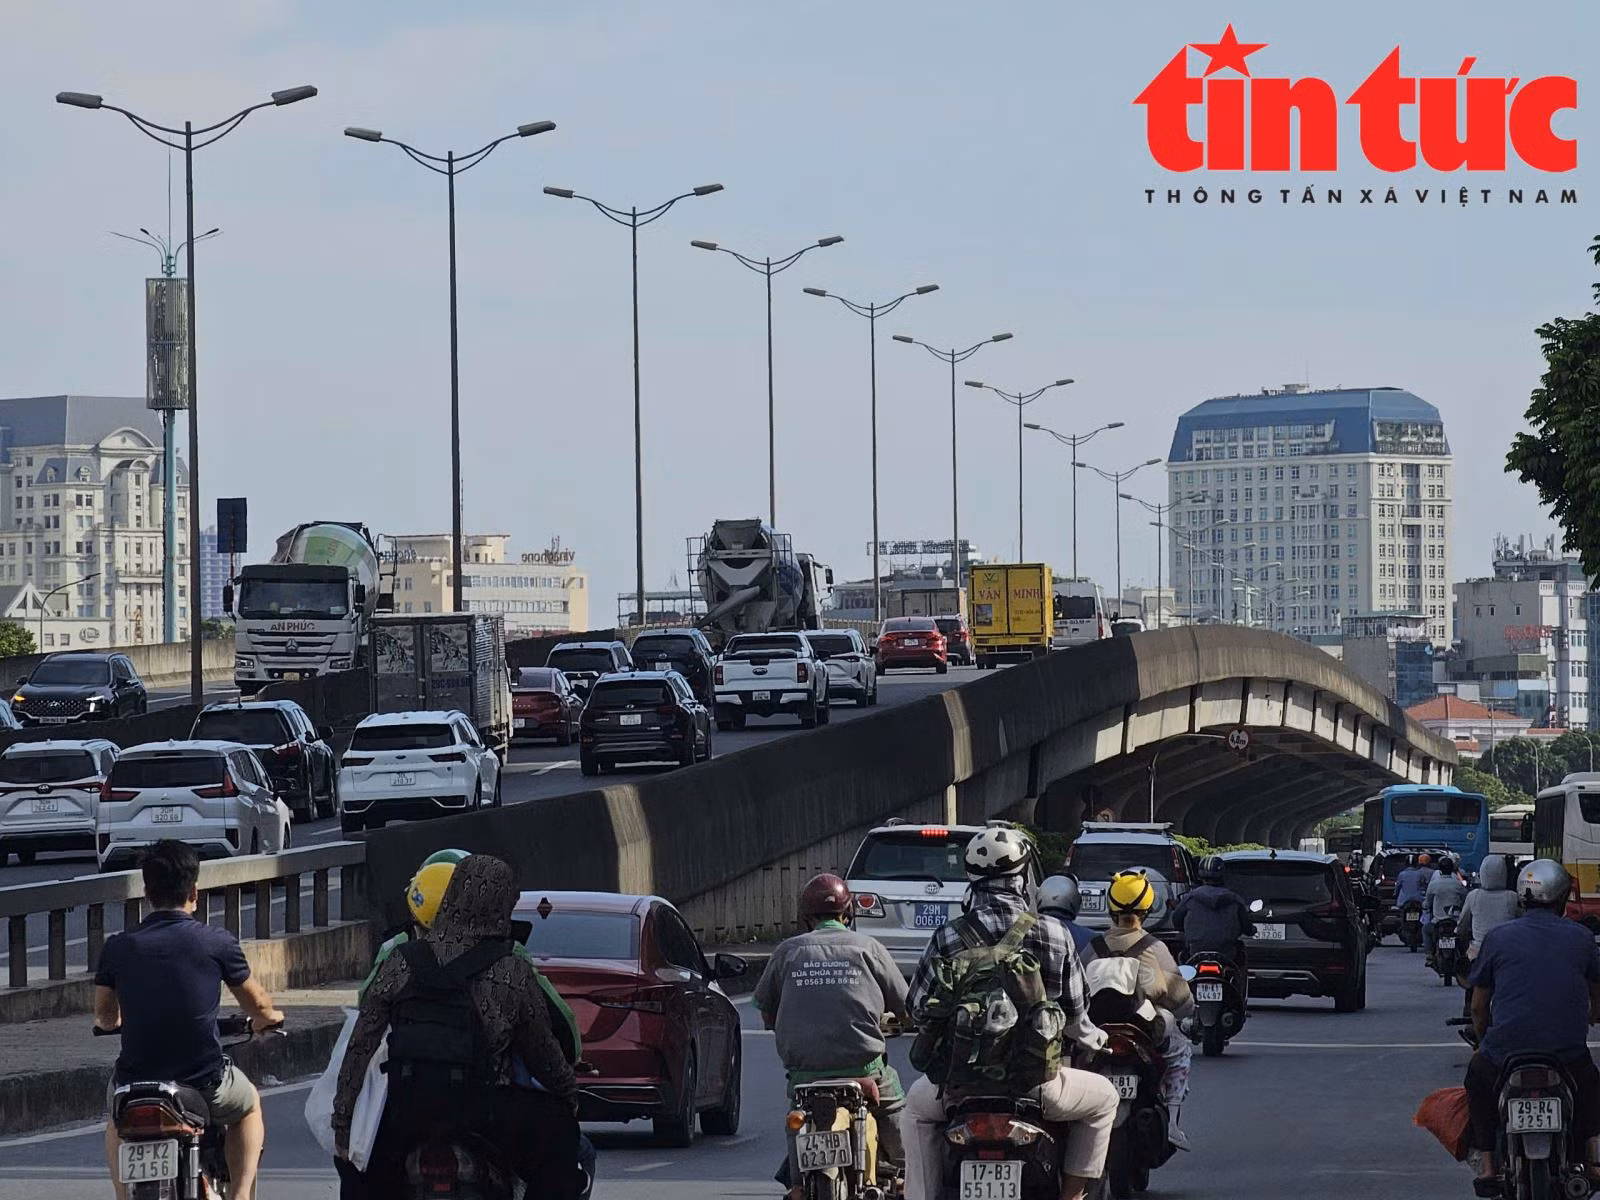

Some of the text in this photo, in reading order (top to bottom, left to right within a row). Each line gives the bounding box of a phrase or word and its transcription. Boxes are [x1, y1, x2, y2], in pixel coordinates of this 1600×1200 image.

[1013, 588, 1041, 600] MINH
[270, 622, 286, 631] AN
[922, 904, 941, 915] 29M
[804, 978, 824, 986] 0563
[825, 977, 836, 985] 86
[1517, 1101, 1553, 1114] 29-R4
[1517, 1114, 1553, 1129] 3251
[128, 1142, 169, 1162] 29-K2
[127, 1160, 169, 1180] 2156
[971, 1164, 1011, 1181] 17-B3
[964, 1182, 1017, 1199] 551.13
